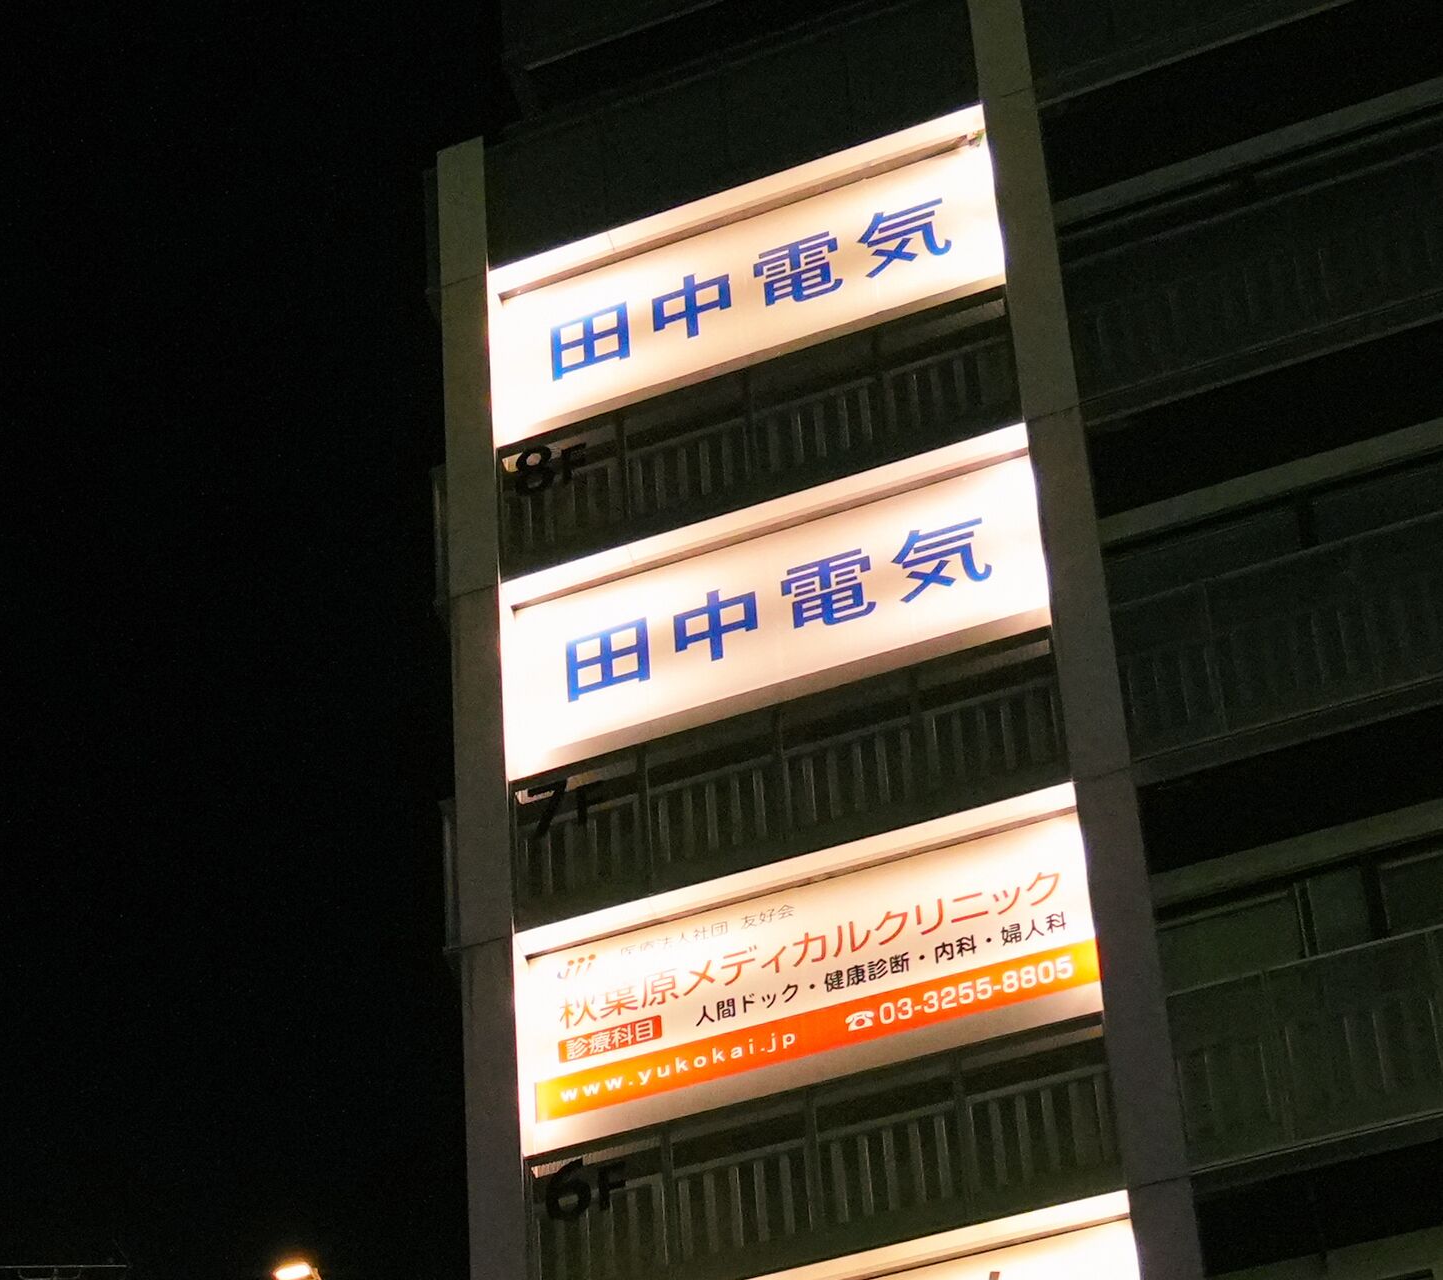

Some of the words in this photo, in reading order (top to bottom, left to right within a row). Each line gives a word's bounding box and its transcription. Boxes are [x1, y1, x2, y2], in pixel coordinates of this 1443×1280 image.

[549, 198, 951, 381] 田中電気
[515, 444, 587, 496] 8F
[564, 517, 992, 702] 田中電気
[558, 870, 1061, 1030] 秋葉原メディカルクリニック
[741, 904, 794, 929] 友好会
[694, 911, 1068, 1027] 人間ドック・健康診断・内科・婦人科
[879, 955, 1074, 1026] 03-3255-8805
[560, 1031, 797, 1103] www.yukokai.jp
[565, 1018, 655, 1060] 診療科目
[545, 1157, 628, 1221] 6F
